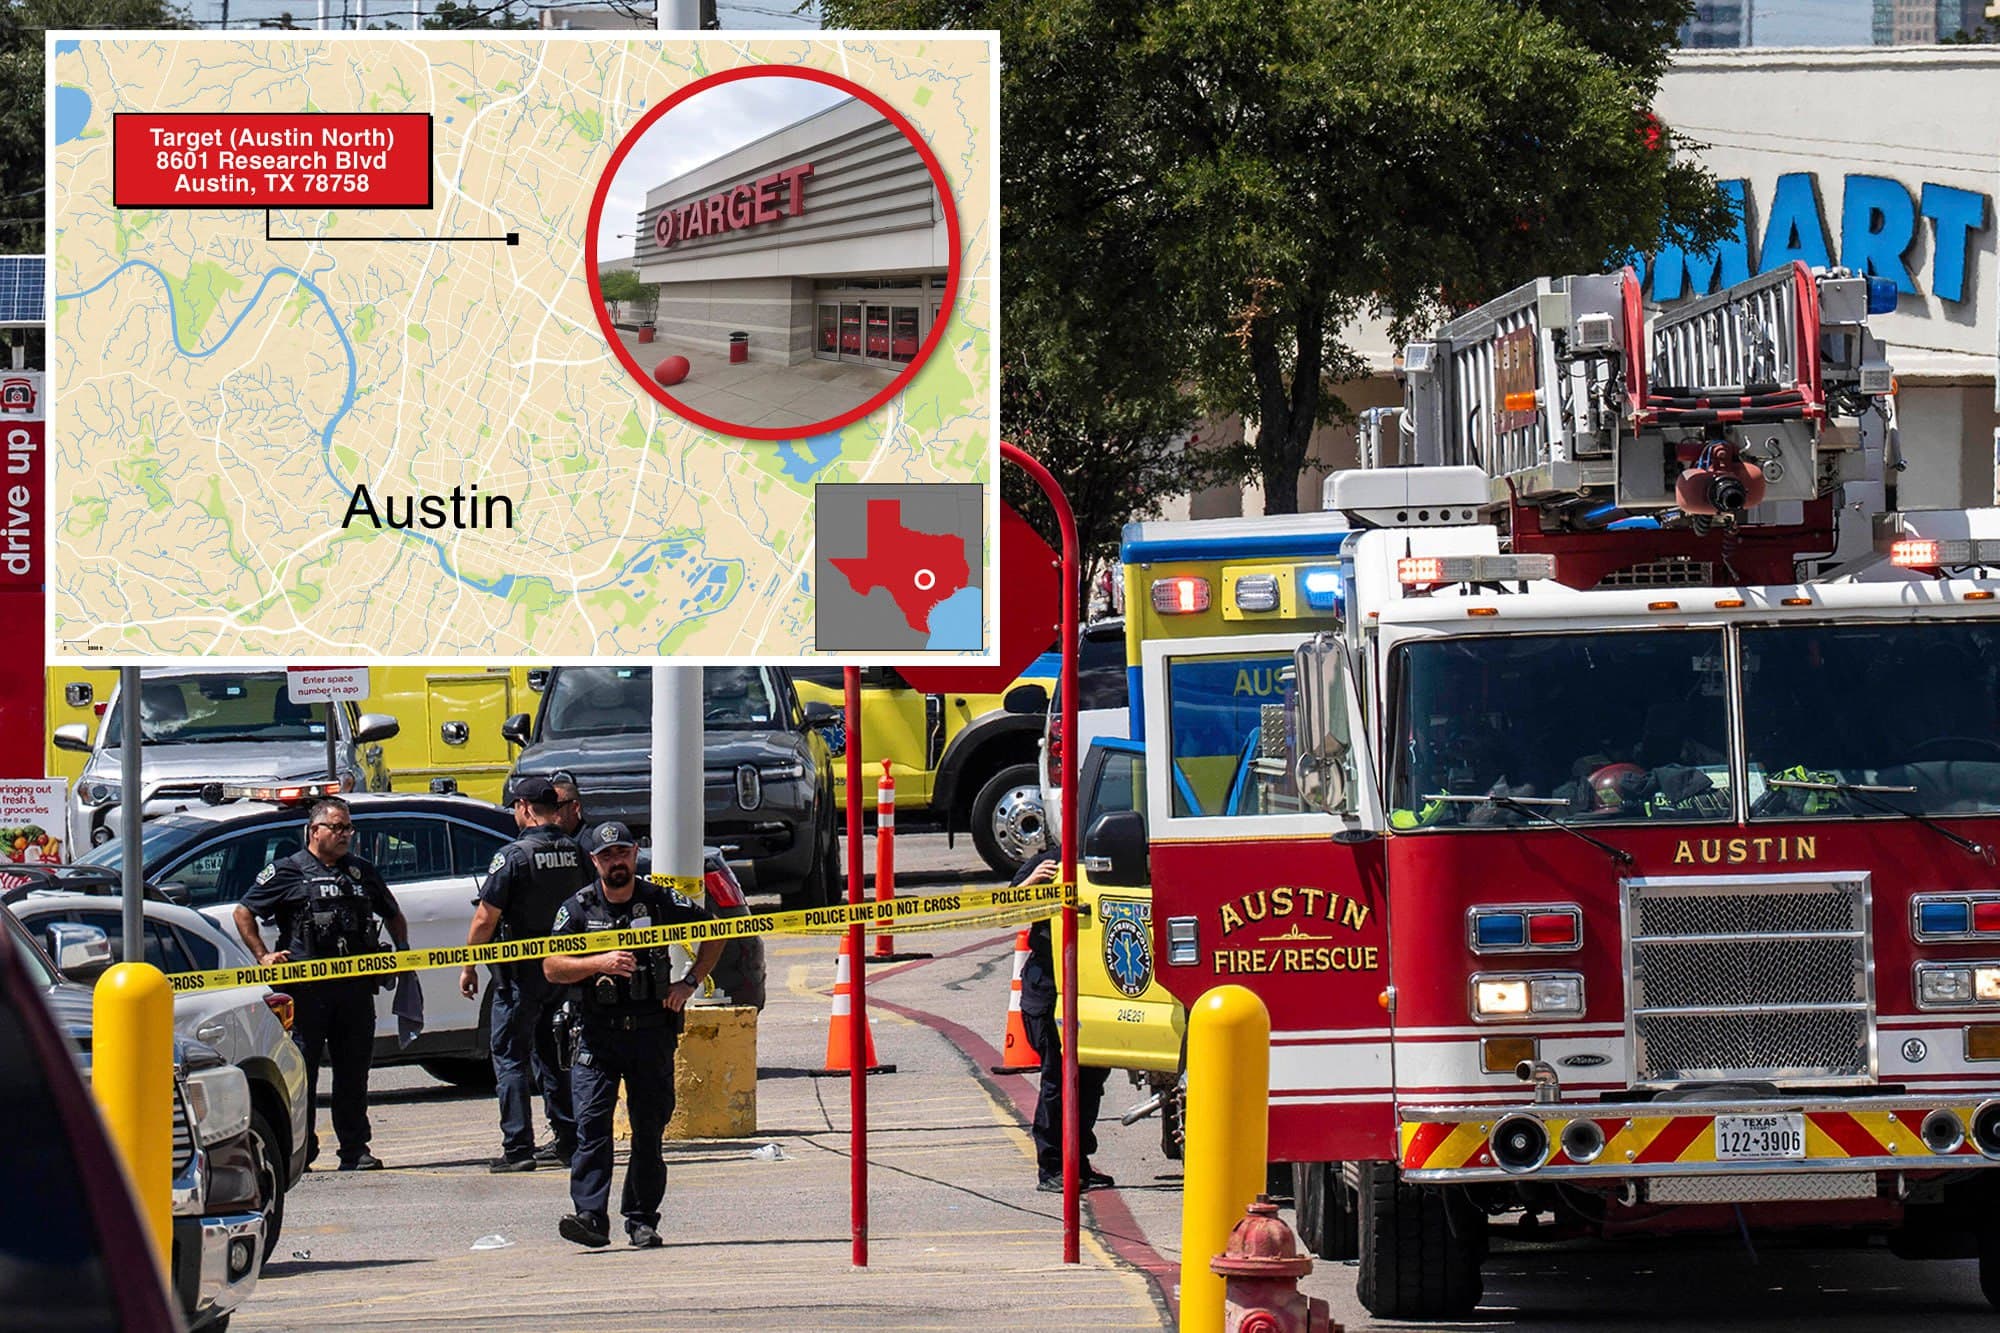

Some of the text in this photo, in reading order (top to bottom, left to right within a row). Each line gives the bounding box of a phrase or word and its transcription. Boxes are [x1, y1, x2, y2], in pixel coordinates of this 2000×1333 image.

[675, 163, 814, 241] TARGET
[1, 428, 37, 575] drive up
[302, 675, 354, 684] Enter space
[297, 687, 331, 696] number
[342, 686, 359, 694] app
[35, 785, 52, 794] out
[2, 795, 36, 805] fresh &
[4, 805, 49, 816] groceries
[1673, 836, 1816, 864] AUSTIN
[534, 851, 579, 870] POLICE
[1219, 887, 1370, 935] AUSTIN
[236, 967, 279, 985] POLICE
[281, 964, 307, 981] LINE
[311, 962, 328, 977] DO
[331, 959, 354, 975] NOT
[357, 955, 398, 972] CROSS
[428, 948, 470, 966] POLICE
[472, 945, 499, 962] LINE
[502, 943, 519, 958] DO
[522, 940, 545, 956] NOT
[549, 936, 588, 953] CROSS
[617, 928, 659, 946] POLICE
[662, 925, 688, 942] LINE
[691, 922, 708, 939] DO
[710, 920, 734, 936] NOT
[736, 917, 775, 934] CROSS
[804, 907, 847, 926] POLICE
[849, 904, 874, 922] LINE
[877, 901, 894, 918] DO
[897, 898, 919, 916] NOT
[923, 895, 961, 913] CROSS
[991, 887, 1034, 905] POLICE
[1035, 886, 1061, 900] LINE
[1213, 946, 1379, 975] FIRE/RESCUE
[1117, 1008, 1146, 1023] 24E251
[1742, 1117, 1777, 1127] TEXAS
